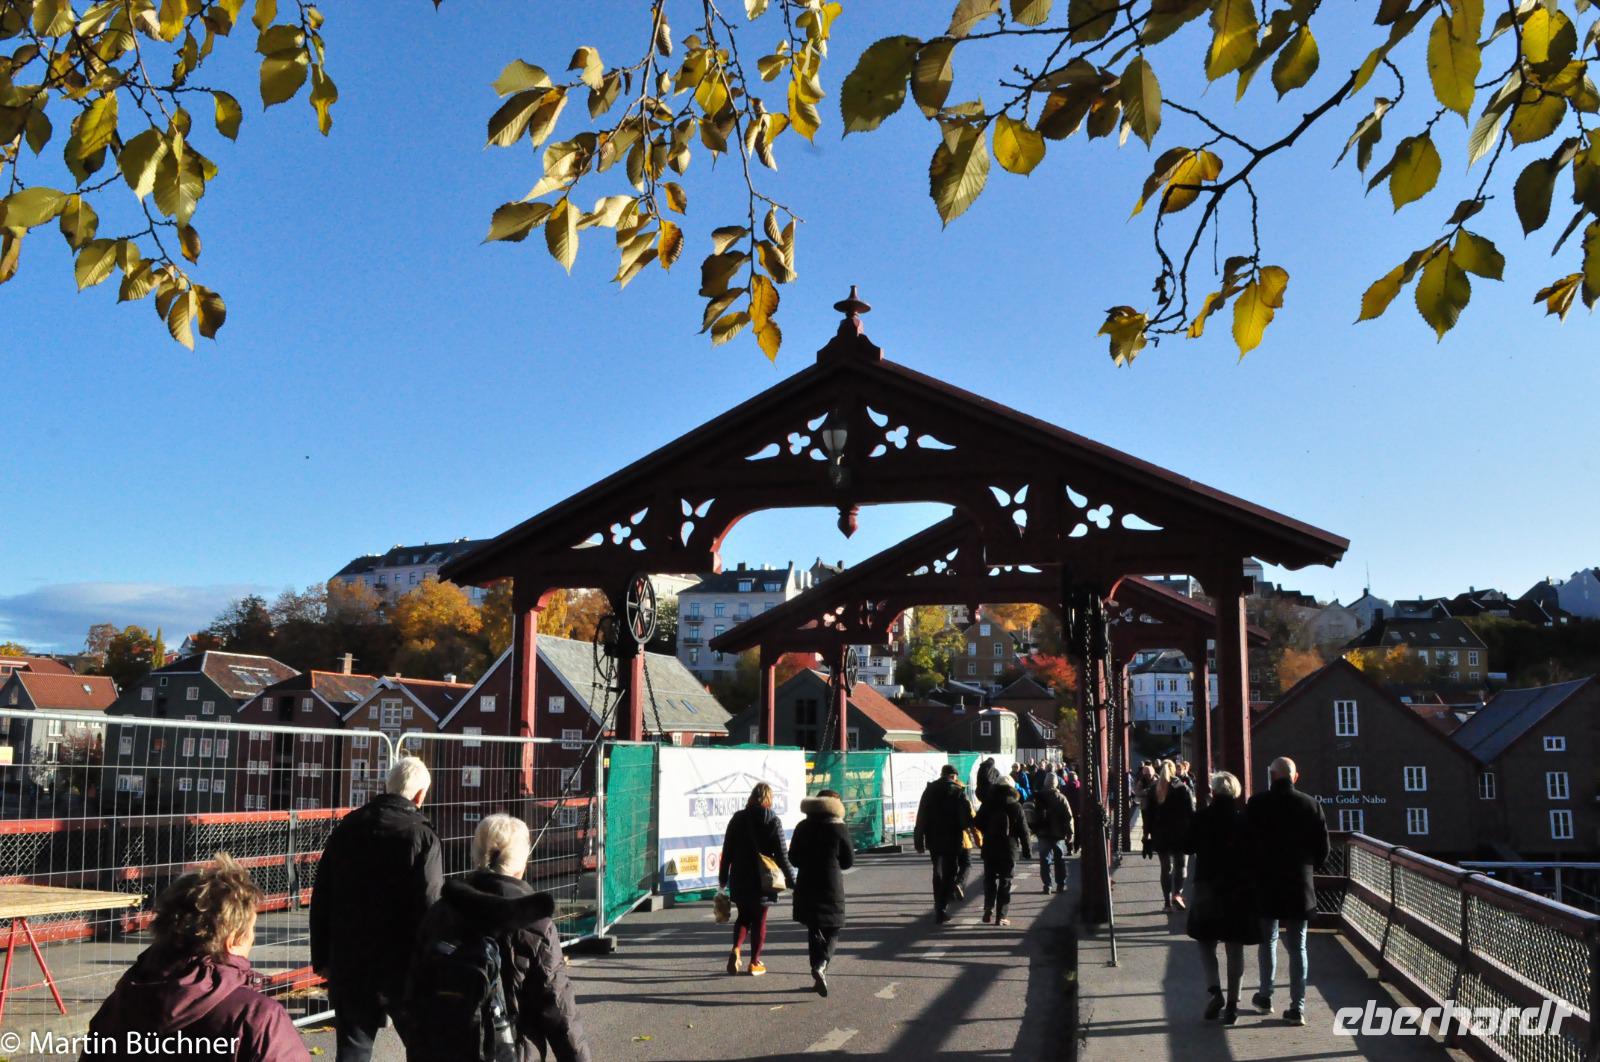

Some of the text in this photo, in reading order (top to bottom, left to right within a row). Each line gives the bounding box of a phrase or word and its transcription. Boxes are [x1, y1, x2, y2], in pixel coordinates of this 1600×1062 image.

[1314, 794, 1387, 804] Den Gode Nabo
